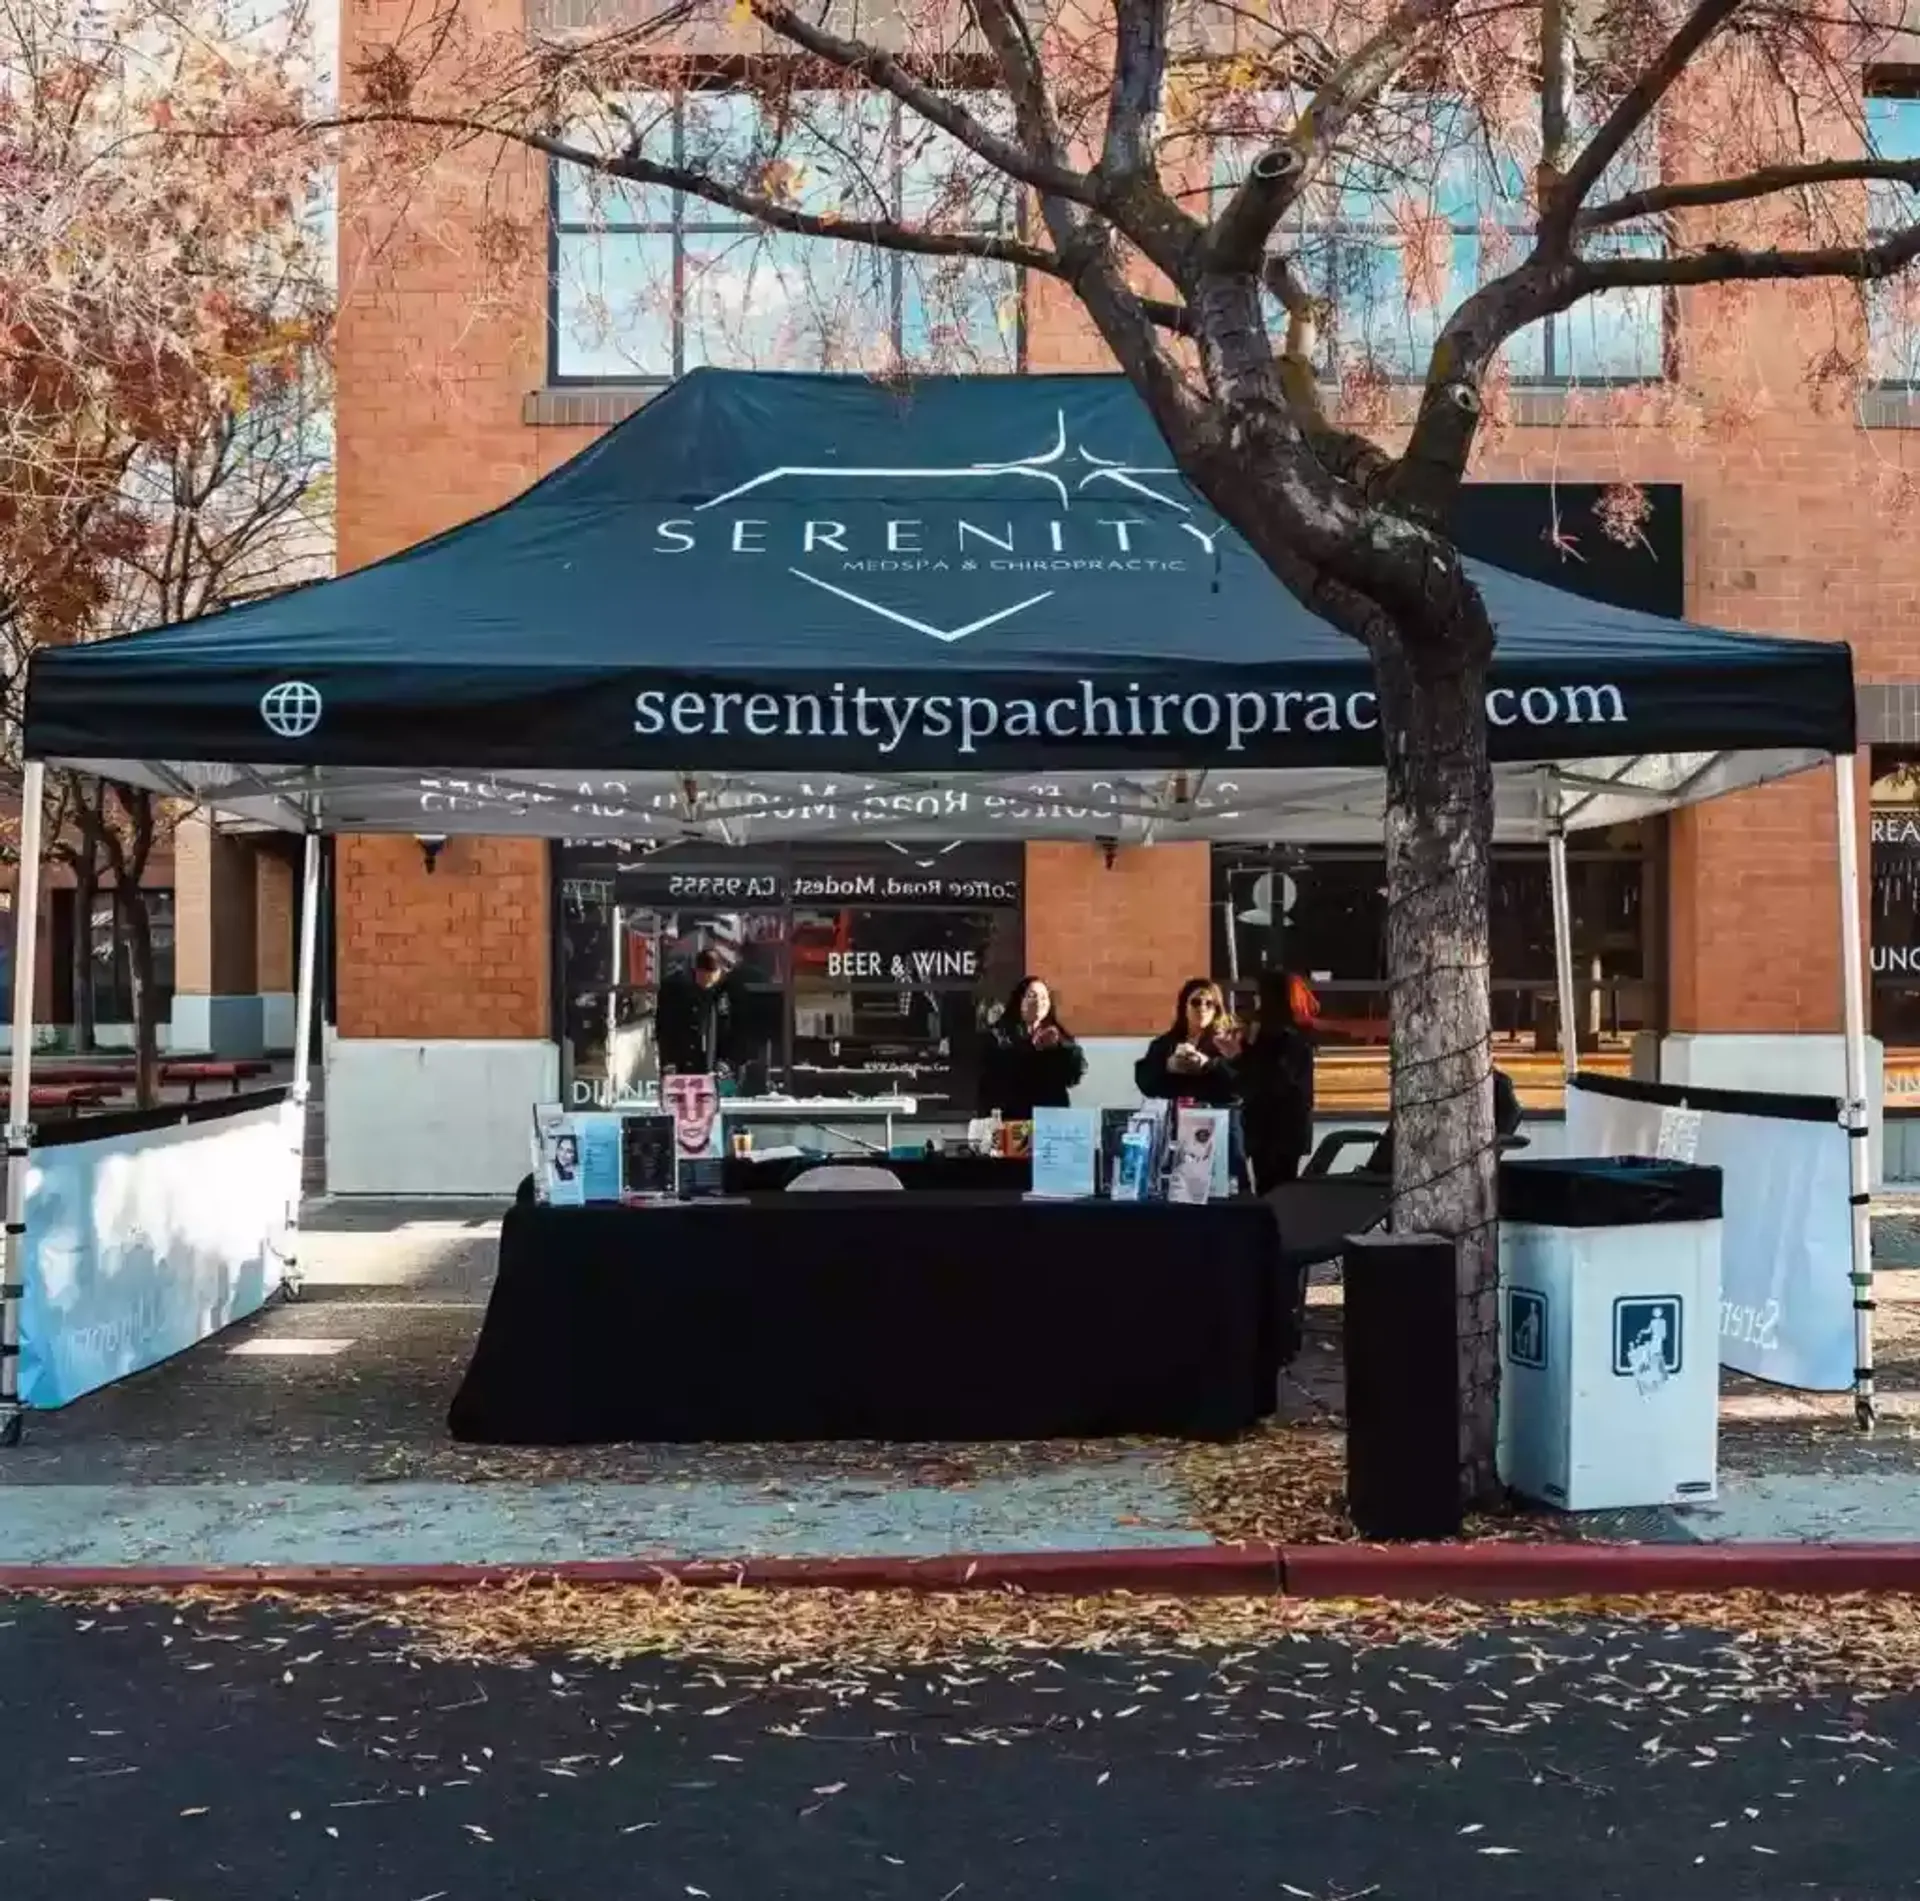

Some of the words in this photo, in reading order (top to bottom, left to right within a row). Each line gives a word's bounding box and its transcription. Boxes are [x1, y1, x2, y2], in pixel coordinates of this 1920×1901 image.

[653, 518, 1226, 554] SERENITY
[842, 558, 950, 573] MEDSPA
[960, 558, 978, 572] &
[988, 558, 1187, 573] CHIROPRACTIC
[633, 680, 1627, 753] serenityspachiropraccom
[828, 951, 881, 977] BEER
[890, 954, 905, 977] &
[912, 950, 977, 977] WINE
